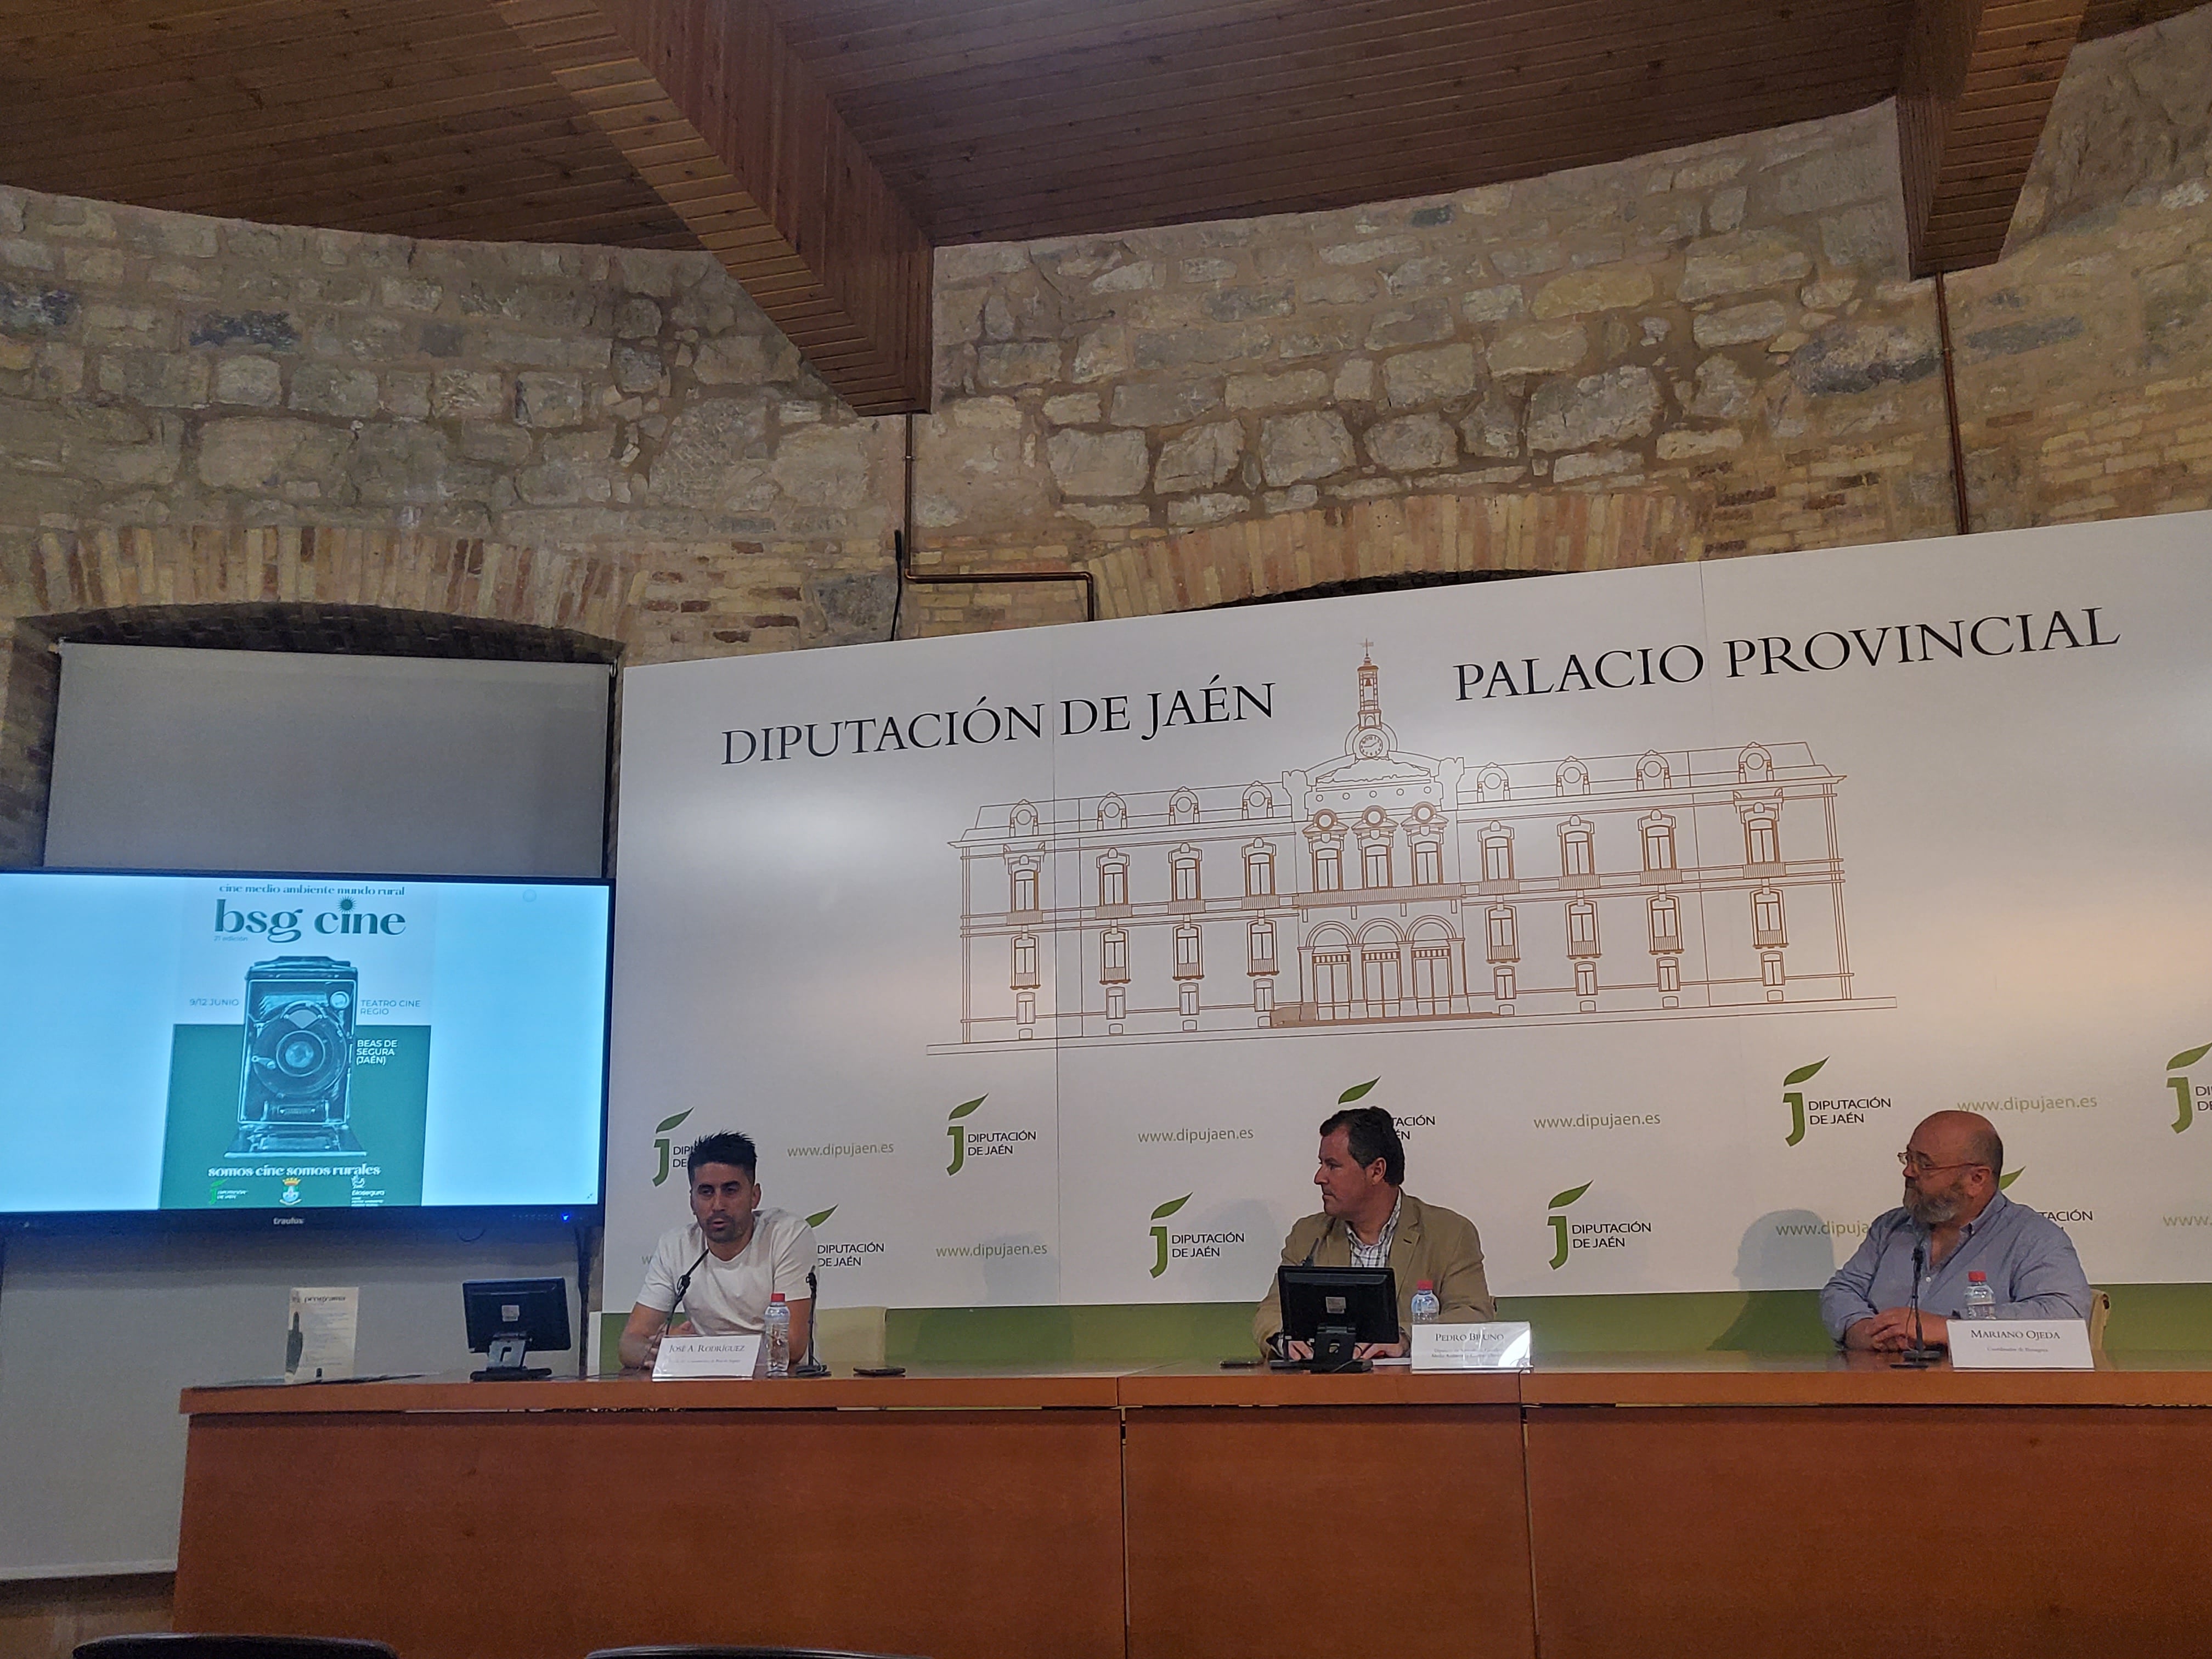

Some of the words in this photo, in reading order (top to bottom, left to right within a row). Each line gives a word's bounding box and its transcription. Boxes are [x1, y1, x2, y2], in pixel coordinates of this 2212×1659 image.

[1453, 644, 1705, 702] PALACIO
[1723, 607, 2121, 679] PROVINCIAL
[721, 696, 1045, 766] DIPUTACIÓN
[1060, 696, 1130, 736] DE
[1141, 674, 1276, 741] JAÉN
[219, 884, 243, 893] cine
[245, 884, 280, 893] medio
[283, 884, 335, 894] ambiente
[337, 885, 376, 895] mundo
[377, 887, 405, 895] rural
[215, 898, 303, 944] bsg
[314, 895, 407, 935] cine
[357, 1039, 382, 1047] BEAS
[356, 1055, 386, 1065] (JAÉN)
[1808, 1097, 1892, 1111] DIPUTACIÓN
[1957, 1096, 2097, 1113] www.dipujaen.es
[1391, 1115, 1435, 1126] TACIÓN
[1533, 1113, 1661, 1130] www.dipujaen.es
[1809, 1115, 1829, 1125] DE
[1830, 1111, 1864, 1124] JAÉN
[968, 1130, 1036, 1143] DIPUTACIÓN
[1138, 1127, 1254, 1144] www.dipujaen.es
[787, 1143, 894, 1158] www.dipujaen.es
[968, 1147, 983, 1156] DE
[984, 1144, 1013, 1155] JAÉN
[673, 1159, 687, 1167] DE
[208, 1166, 254, 1177] somos
[255, 1164, 284, 1177] cine
[286, 1166, 331, 1177] somos
[332, 1163, 381, 1176] rurales
[2036, 1209, 2093, 1222] TACIÓN
[1572, 1221, 1651, 1234] DIPUTACIÓN
[1776, 1220, 1870, 1237] www.dipuja
[1171, 1232, 1244, 1244] DIPUTACIÓN
[1572, 1239, 1591, 1249] DE
[1592, 1235, 1625, 1248] JAÉN
[817, 1241, 884, 1254] DIPUTACIÓN
[935, 1243, 1047, 1259] www.dipujaen.es
[1172, 1248, 1188, 1257] DE
[1190, 1246, 1220, 1257] JAÉN
[833, 1255, 861, 1267] JAÉN
[1435, 1333, 1467, 1341] PEDRO
[1971, 1329, 2024, 1339] MARIANO
[2025, 1330, 2061, 1341] OJEDA
[697, 1344, 745, 1352] RODRÍGUEZ
